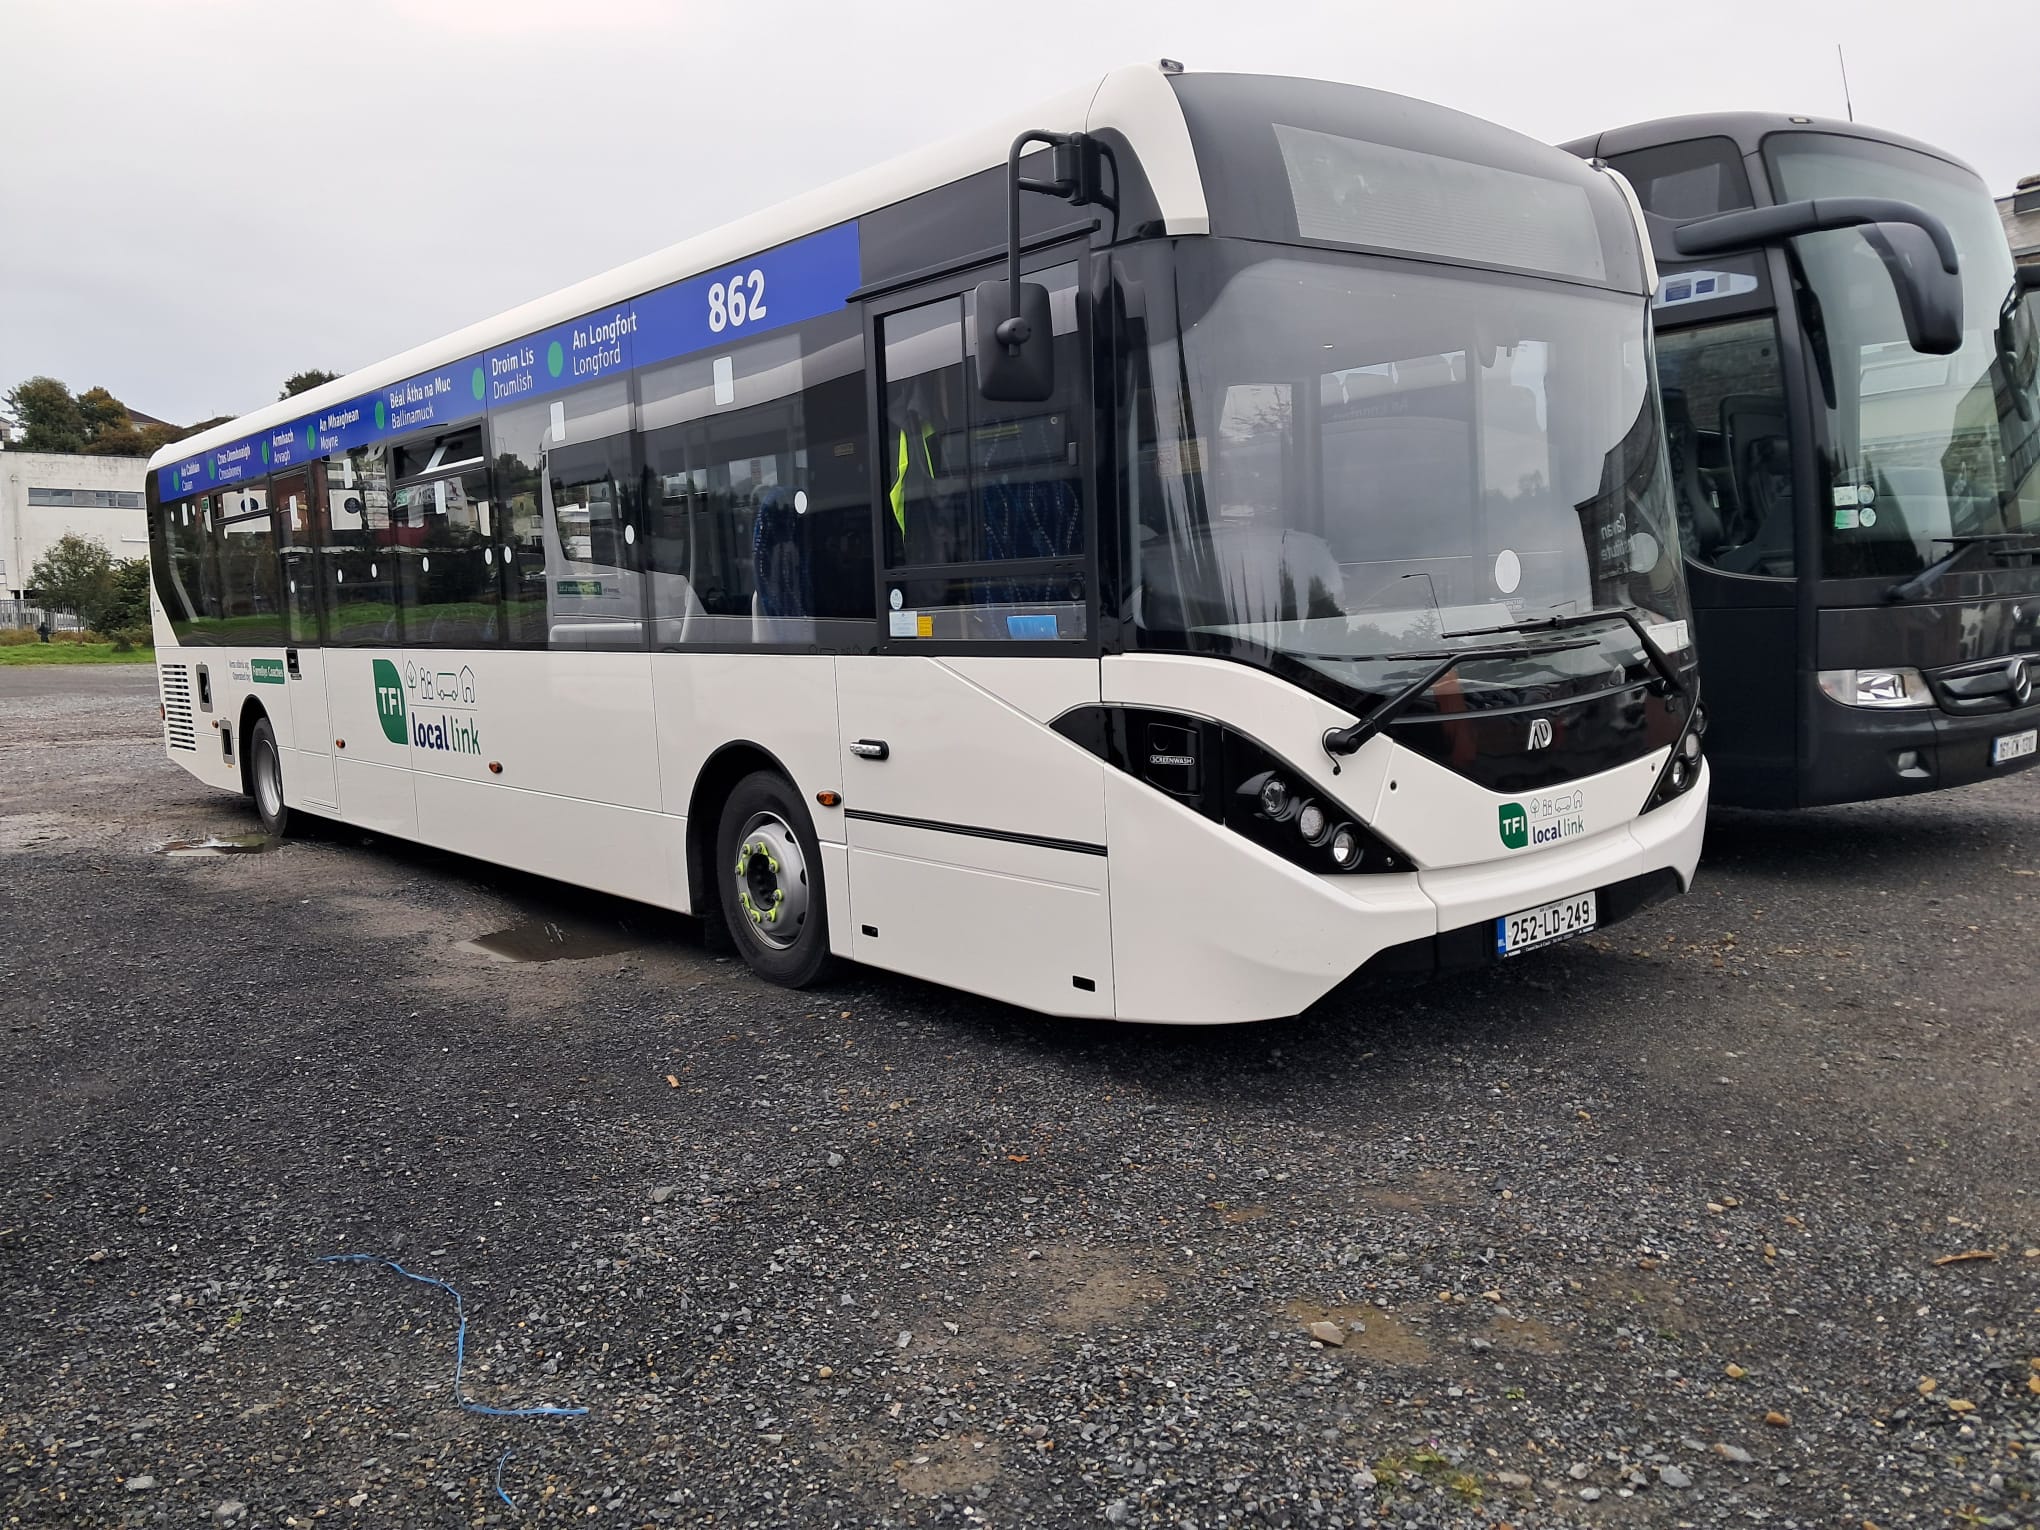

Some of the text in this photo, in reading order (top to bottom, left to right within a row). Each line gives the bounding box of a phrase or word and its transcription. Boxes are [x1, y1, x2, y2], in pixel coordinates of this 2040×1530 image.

[708, 269, 767, 333] 862
[573, 312, 638, 350] An Longfort
[492, 347, 535, 377] Droim Lis
[573, 342, 621, 376] Longford
[389, 376, 451, 409] Béal Átha na Muc
[493, 369, 533, 399] Drumlish
[319, 408, 360, 432] An Mhaighean
[391, 402, 434, 429] Ballinamuck
[320, 434, 339, 451] Moyne
[378, 686, 403, 716] TFI
[411, 711, 481, 755] local link
[1151, 755, 1193, 764] SCREENWASH
[1502, 815, 1525, 835] TFI
[1533, 815, 1585, 844] local link
[1511, 900, 1590, 947] 252-LD-249
